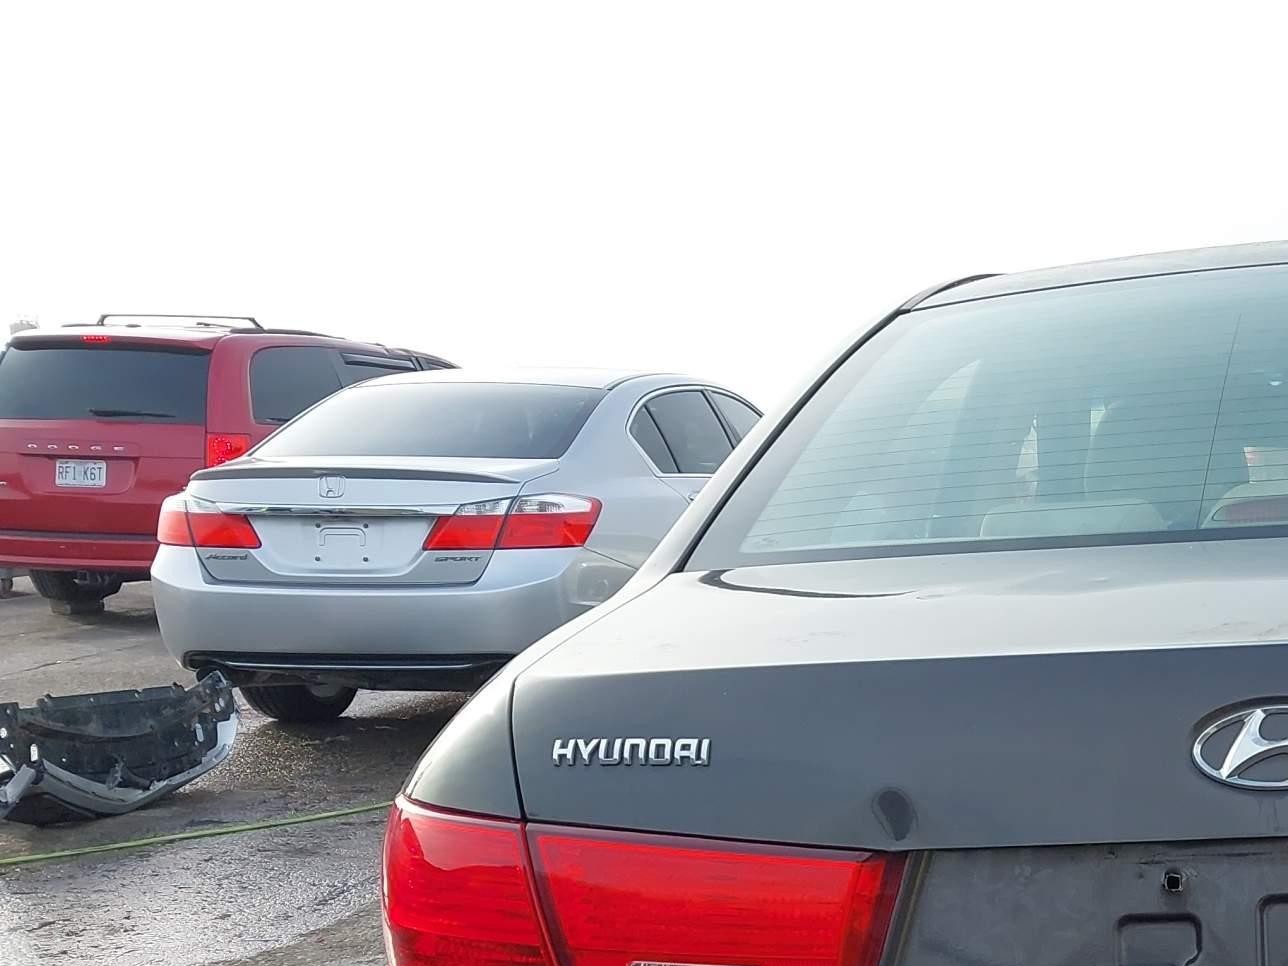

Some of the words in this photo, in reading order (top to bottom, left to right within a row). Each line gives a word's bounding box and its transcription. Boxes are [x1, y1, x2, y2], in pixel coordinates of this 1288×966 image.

[57, 465, 77, 481] RF1
[82, 467, 102, 481] K6T
[552, 737, 711, 767] HYUNDAI
